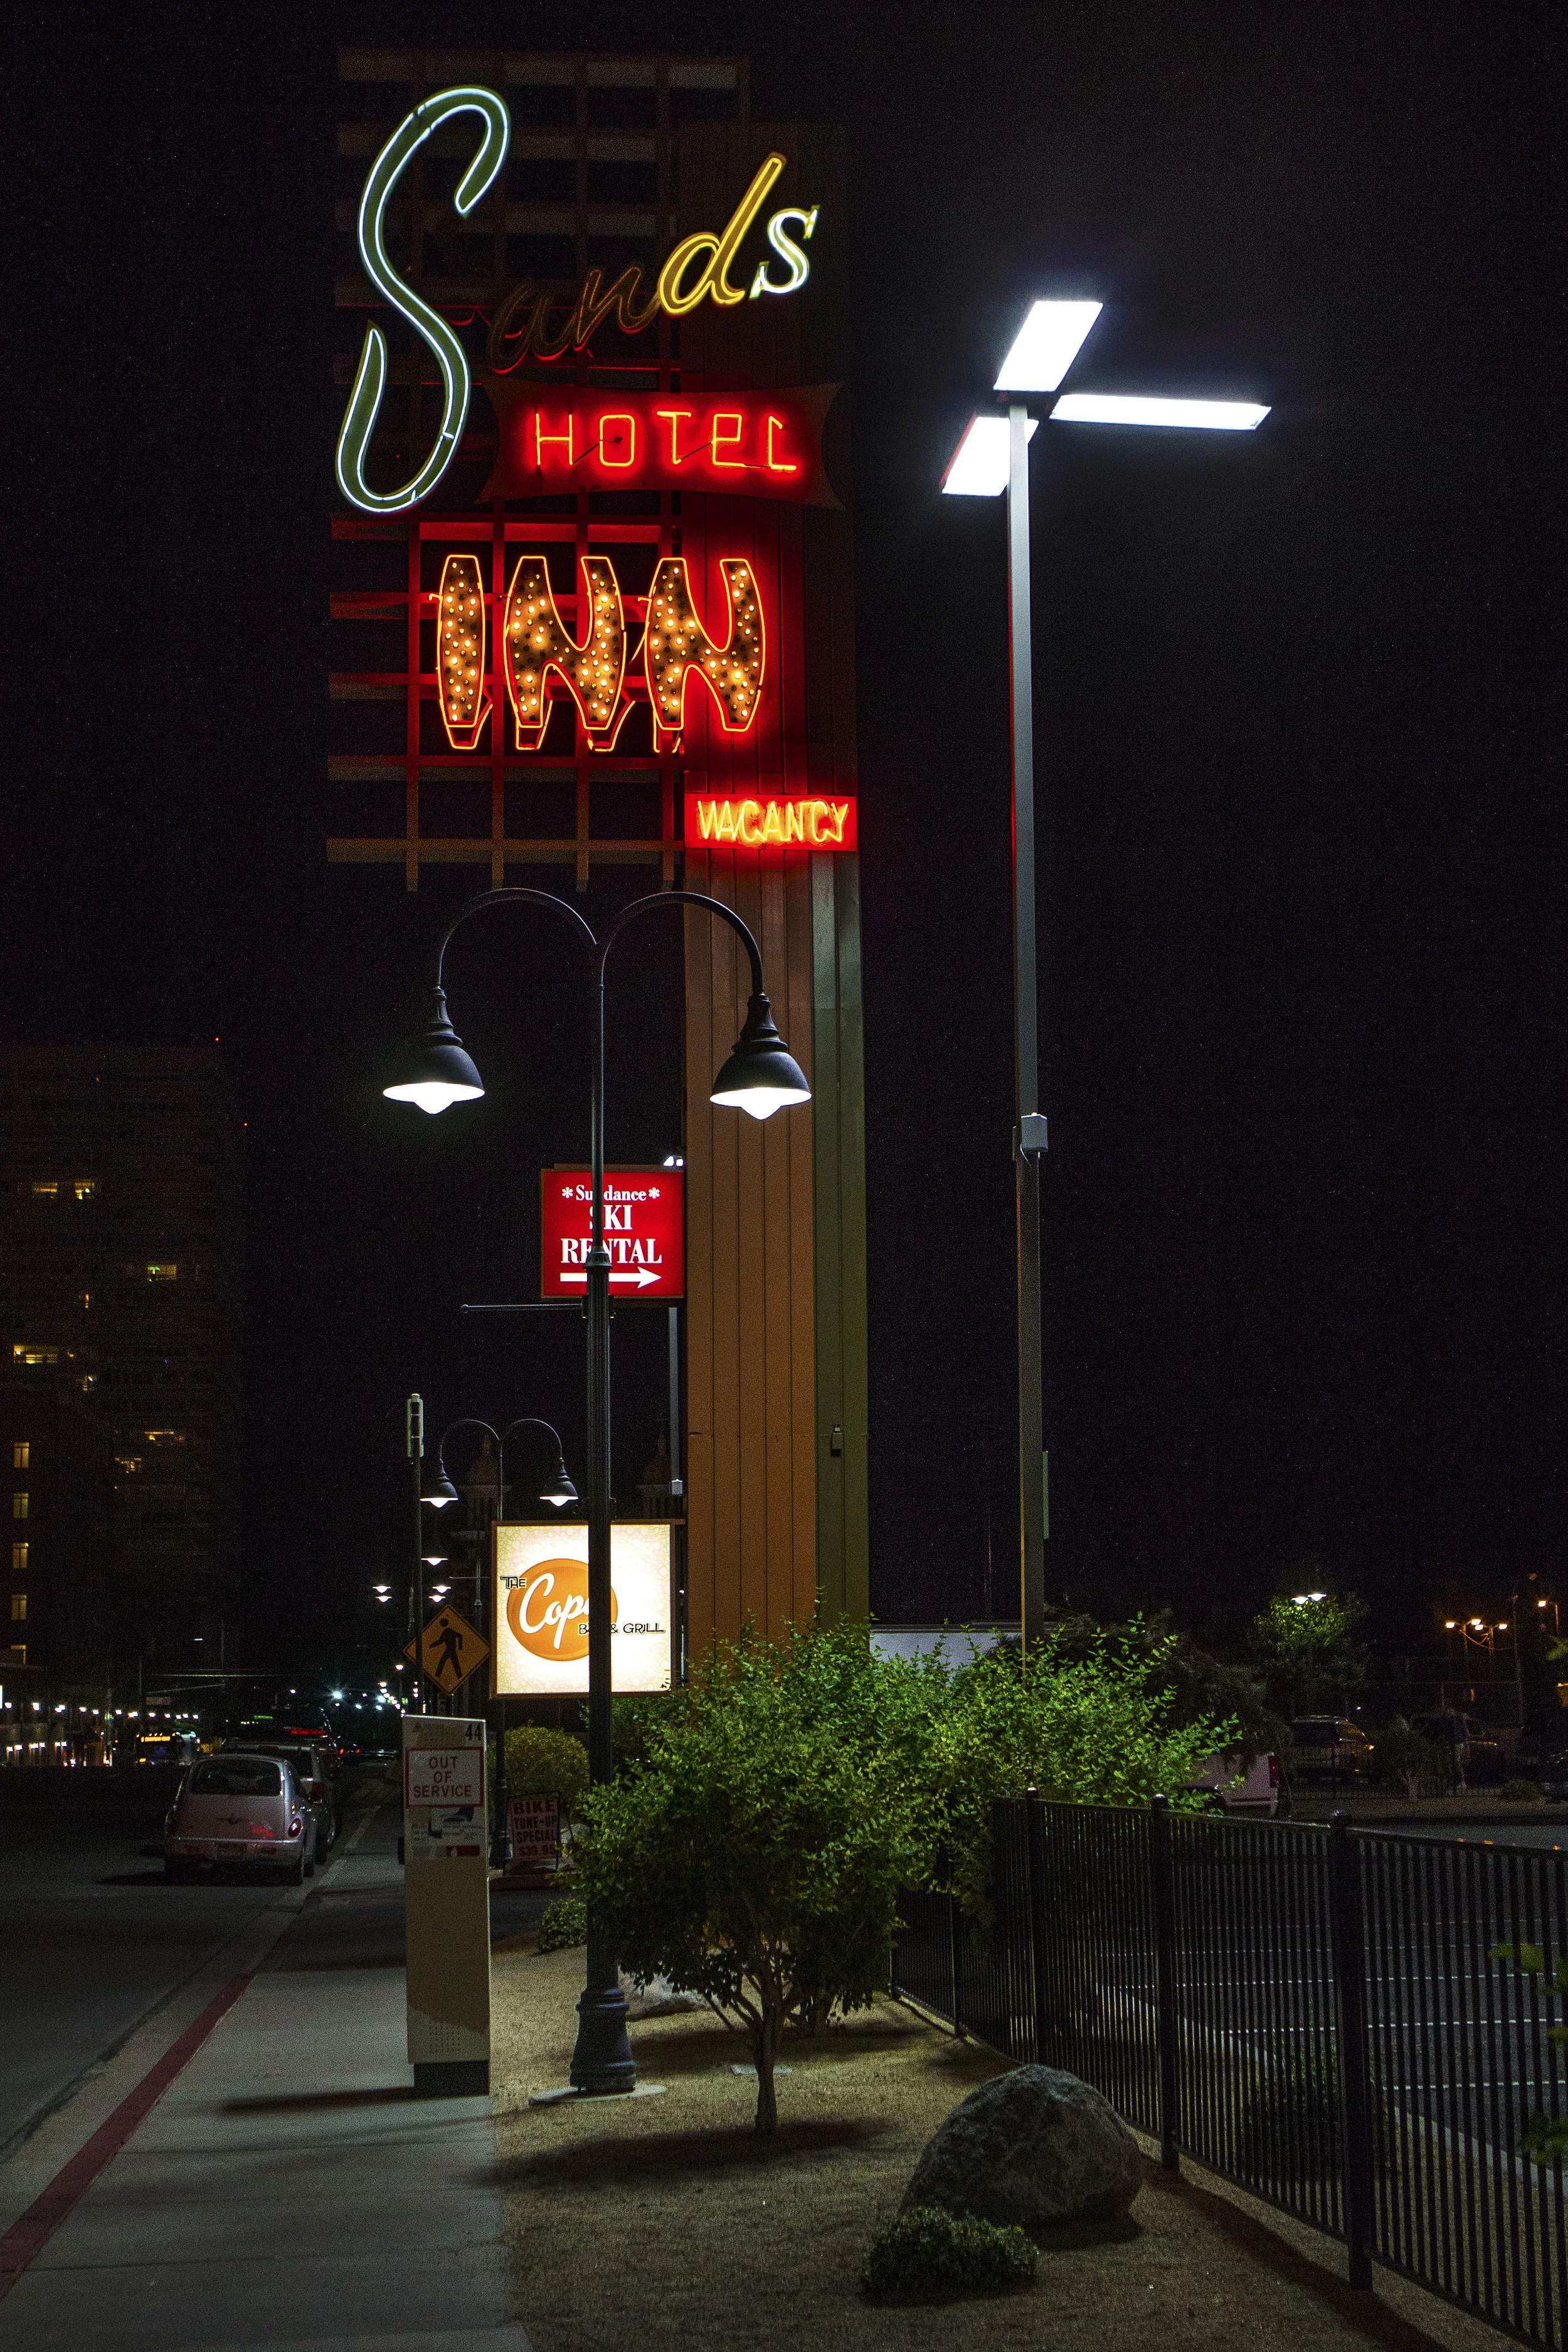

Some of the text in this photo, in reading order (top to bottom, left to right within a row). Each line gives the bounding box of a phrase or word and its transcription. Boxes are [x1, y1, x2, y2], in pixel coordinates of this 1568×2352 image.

[335, 84, 821, 514] Sands
[534, 410, 798, 472] HOTEL
[437, 555, 766, 732] INN
[697, 799, 850, 843] VACANCY
[576, 1184, 647, 1201] Sudance
[589, 1205, 633, 1230] KI
[501, 1575, 526, 1588] THE
[623, 1622, 665, 1634] GRILL
[465, 1723, 482, 1741] 44
[428, 1756, 458, 1769] OUT
[433, 1770, 452, 1784] OF
[413, 1784, 472, 1799] SERVICE
[513, 1799, 556, 1815] BIKE
[514, 1815, 558, 1829] TUNE-UP
[517, 1829, 558, 1843] SPECIAL
